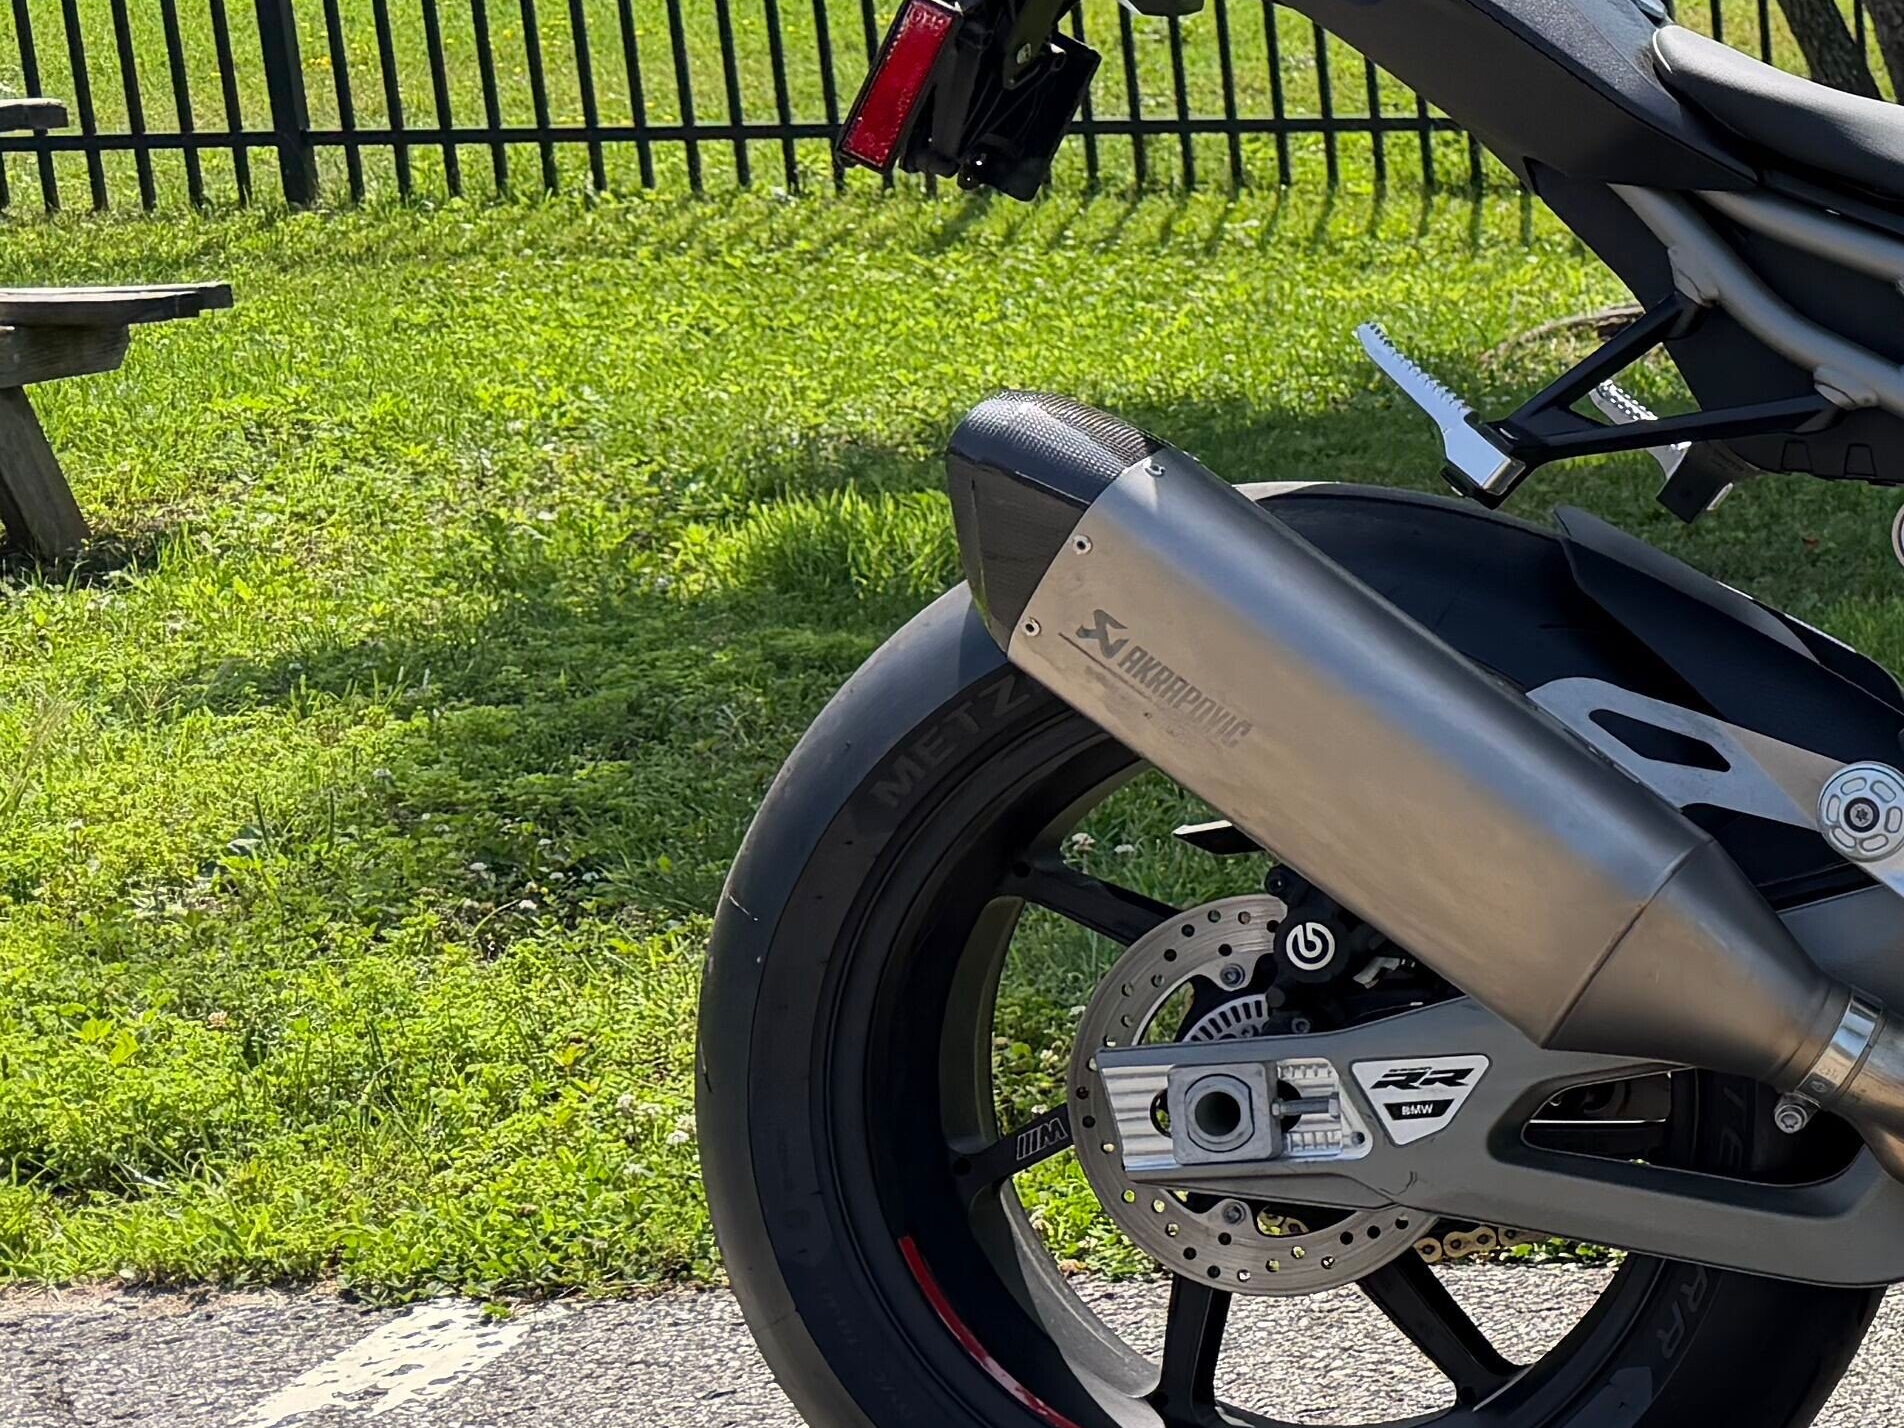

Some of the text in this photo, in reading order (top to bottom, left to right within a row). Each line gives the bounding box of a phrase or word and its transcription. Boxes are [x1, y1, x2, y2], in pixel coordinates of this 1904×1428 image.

[871, 673, 1034, 811] METZ
[1370, 1067, 1475, 1090] RR
[1401, 1103, 1434, 1116] BMW
